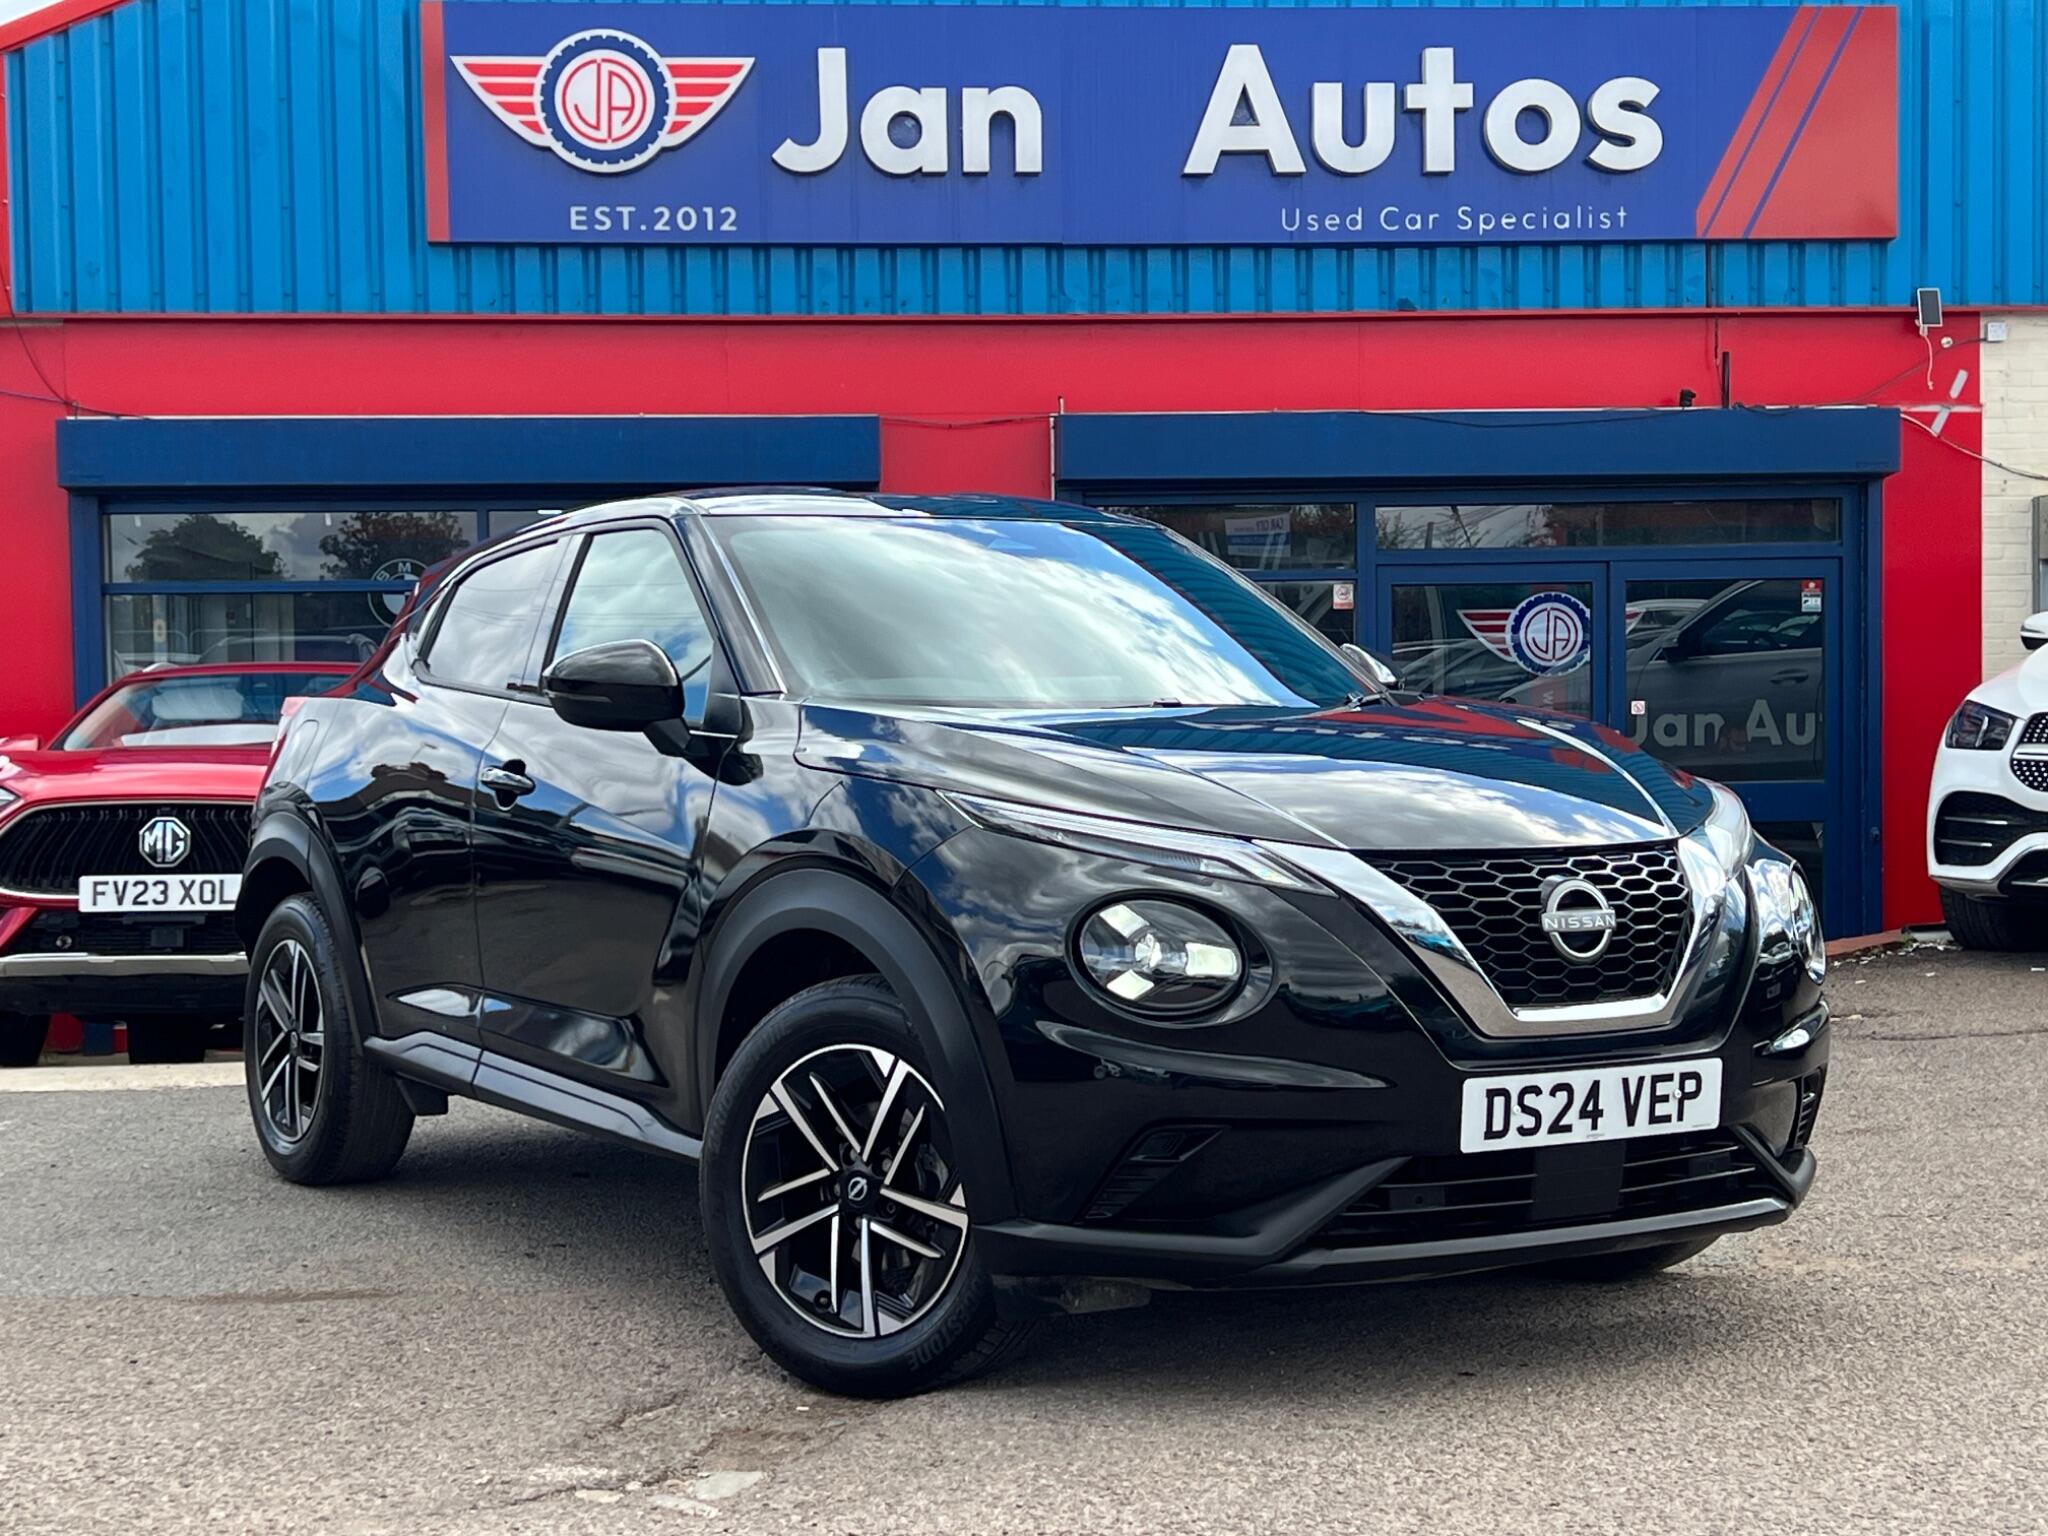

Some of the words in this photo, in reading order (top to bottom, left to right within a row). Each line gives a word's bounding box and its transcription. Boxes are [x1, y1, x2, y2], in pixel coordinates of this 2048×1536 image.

[771, 47, 1043, 174] Jan
[1182, 44, 1664, 175] Autos
[569, 205, 738, 232] EST.2012
[1281, 206, 1363, 232] Used
[1379, 206, 1440, 232] Car
[1456, 205, 1628, 236] Specialist
[1629, 711, 1725, 747] Jan
[1746, 699, 1824, 746] Au
[144, 821, 186, 863] MG
[92, 880, 169, 906] FV23
[178, 879, 237, 906] XOL
[1544, 914, 1616, 929] NISSAN
[1483, 1080, 1604, 1141] DS24
[1621, 1071, 1703, 1128] VEP
